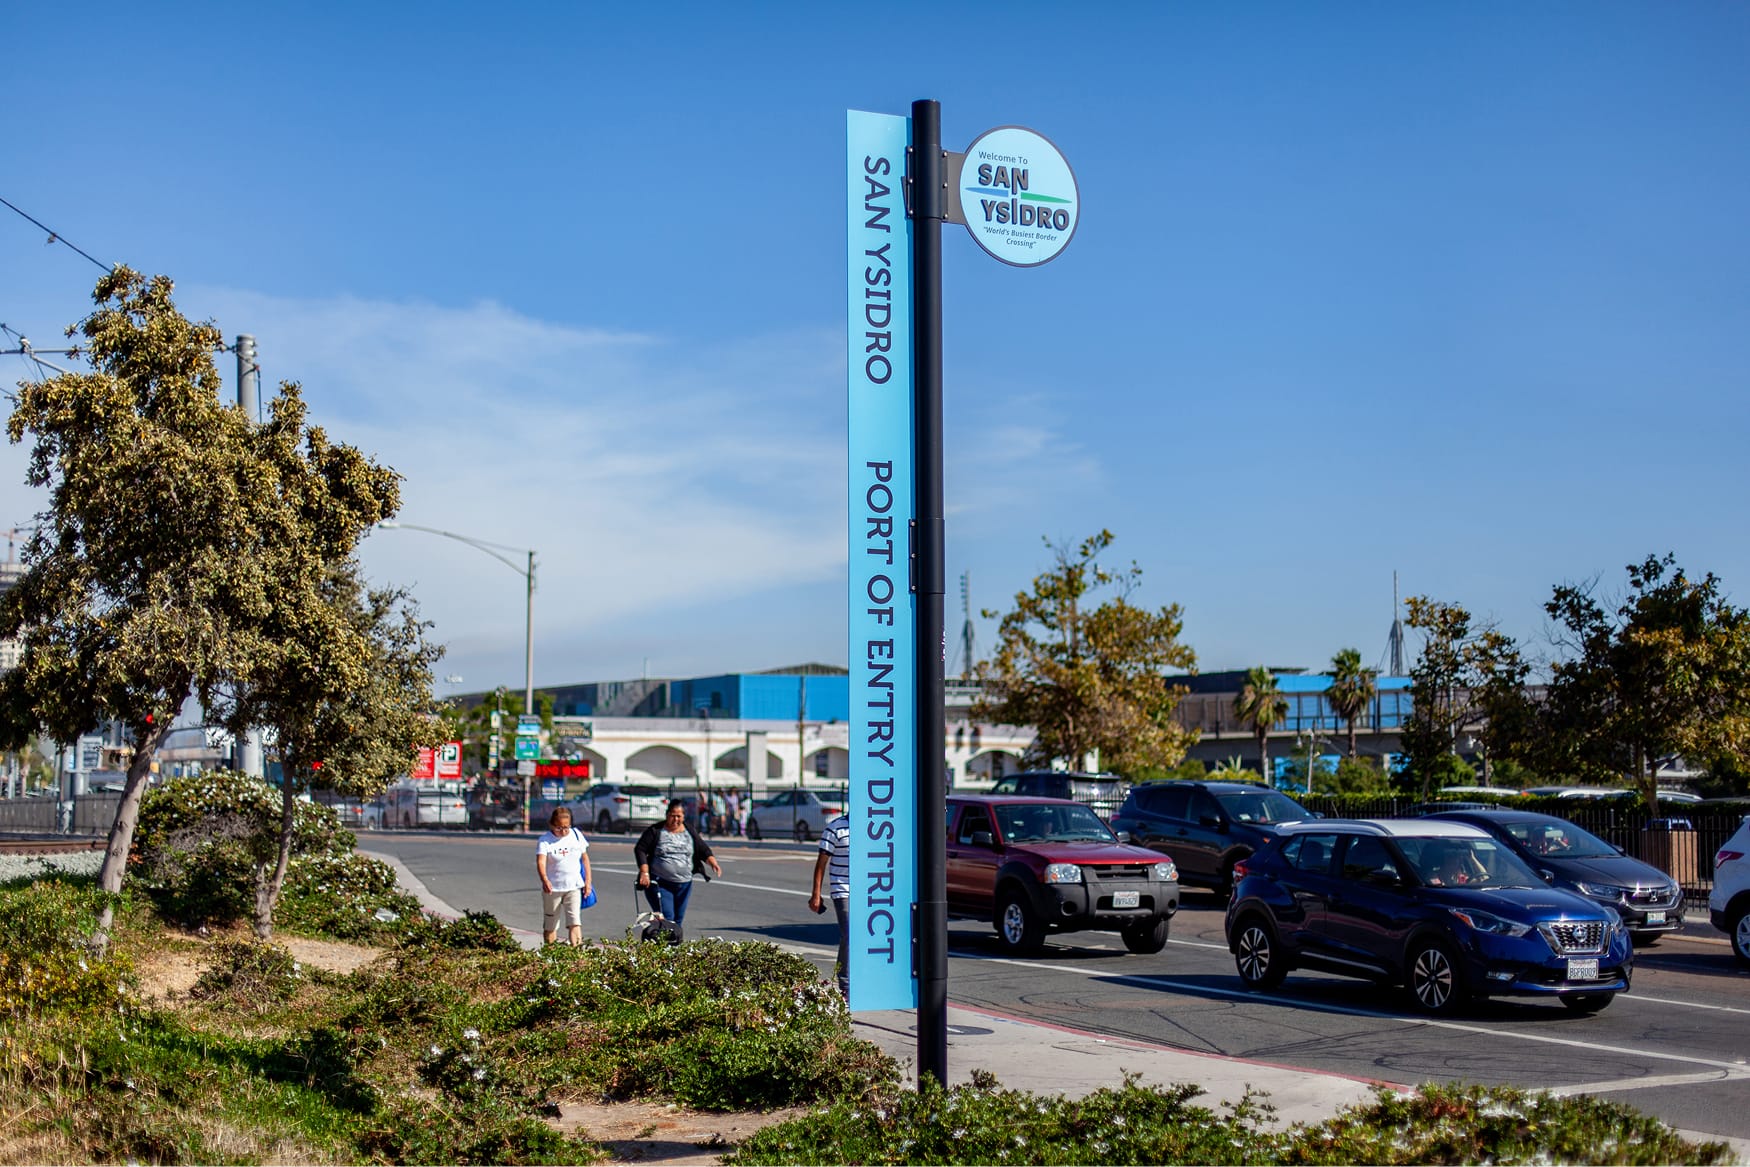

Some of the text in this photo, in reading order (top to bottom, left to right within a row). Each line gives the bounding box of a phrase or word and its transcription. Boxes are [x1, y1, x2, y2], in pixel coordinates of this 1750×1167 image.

[978, 151, 1028, 165] Welcome To
[977, 163, 1029, 195] SAN
[980, 198, 1070, 231] YSIDRO
[1011, 231, 1034, 239] Busiest
[1035, 232, 1057, 241] Border
[864, 155, 892, 384] SAN YSIDRO
[866, 460, 894, 964] PORT OF ENTRY DISTRICT
